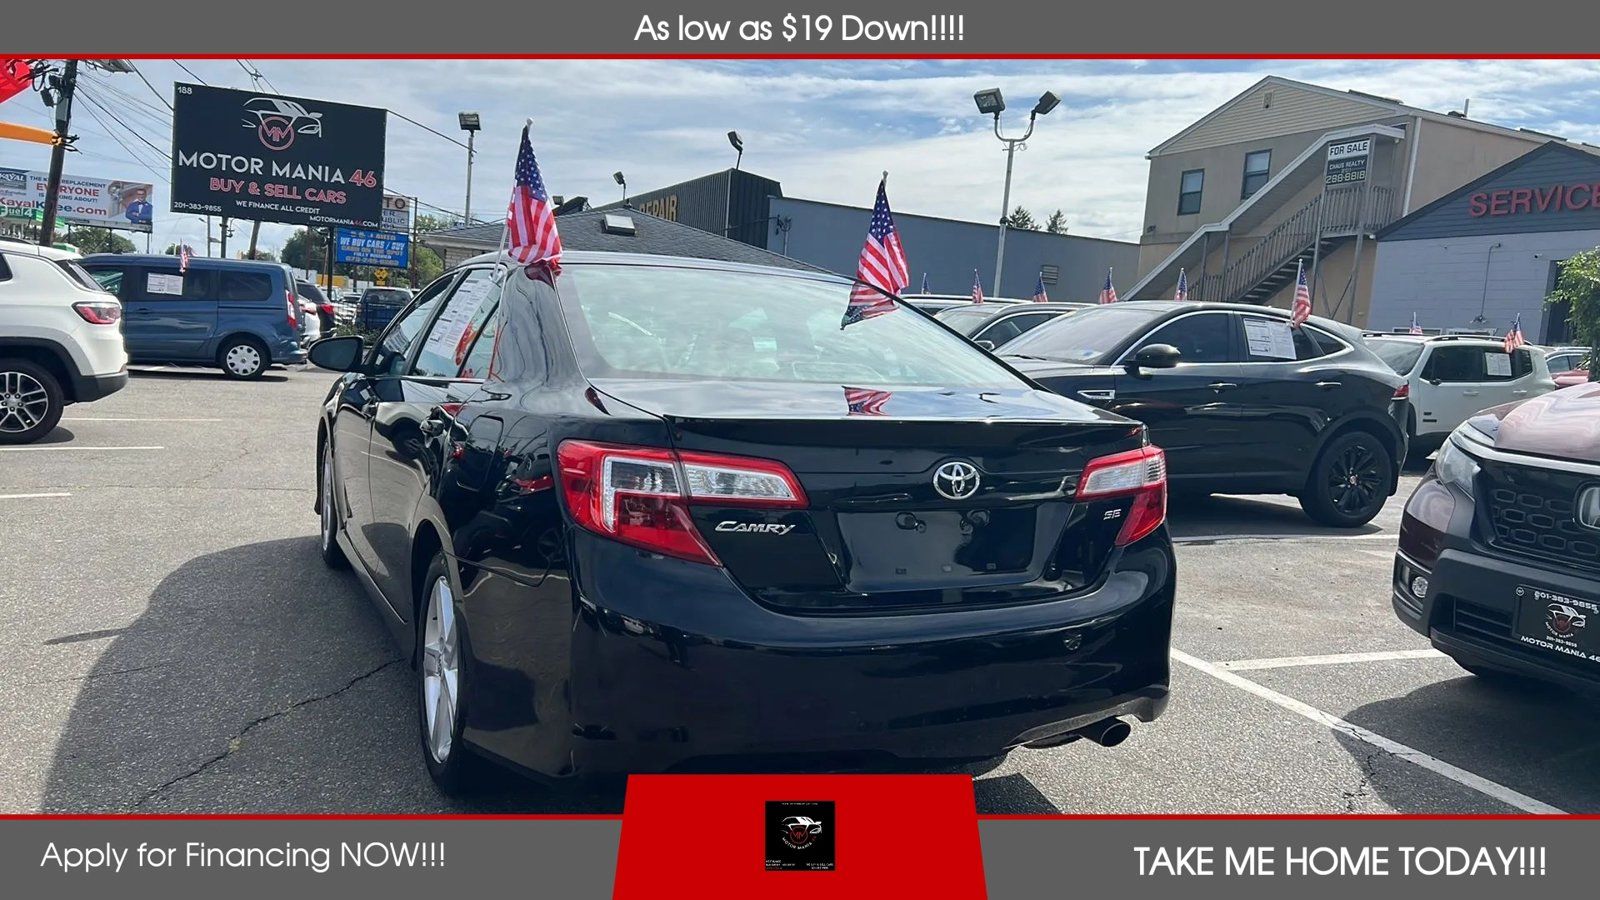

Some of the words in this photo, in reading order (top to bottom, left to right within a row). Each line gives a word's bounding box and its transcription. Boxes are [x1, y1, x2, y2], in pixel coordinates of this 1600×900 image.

[177, 86, 193, 95] 188
[1329, 145, 1345, 156] FOR
[1346, 141, 1368, 154] SALE
[178, 149, 264, 175] MOTOR
[271, 160, 346, 184] MANIA
[348, 169, 377, 188] 46
[61, 179, 107, 188] REPLACEMENT
[209, 177, 245, 193] BUY
[247, 181, 261, 195] &
[264, 183, 302, 200] SELL
[304, 187, 347, 204] CARS
[174, 201, 222, 212] 201-383-9855
[235, 200, 247, 208] WE
[248, 201, 279, 211] FINANCE
[295, 206, 320, 215] CREDIT
[340, 237, 352, 246] WE
[366, 239, 386, 249] CARS
[1103, 508, 1122, 521] SE
[714, 520, 796, 536] CAMRY
[1520, 635, 1554, 650] MOTOR
[1554, 645, 1587, 659] MANIA
